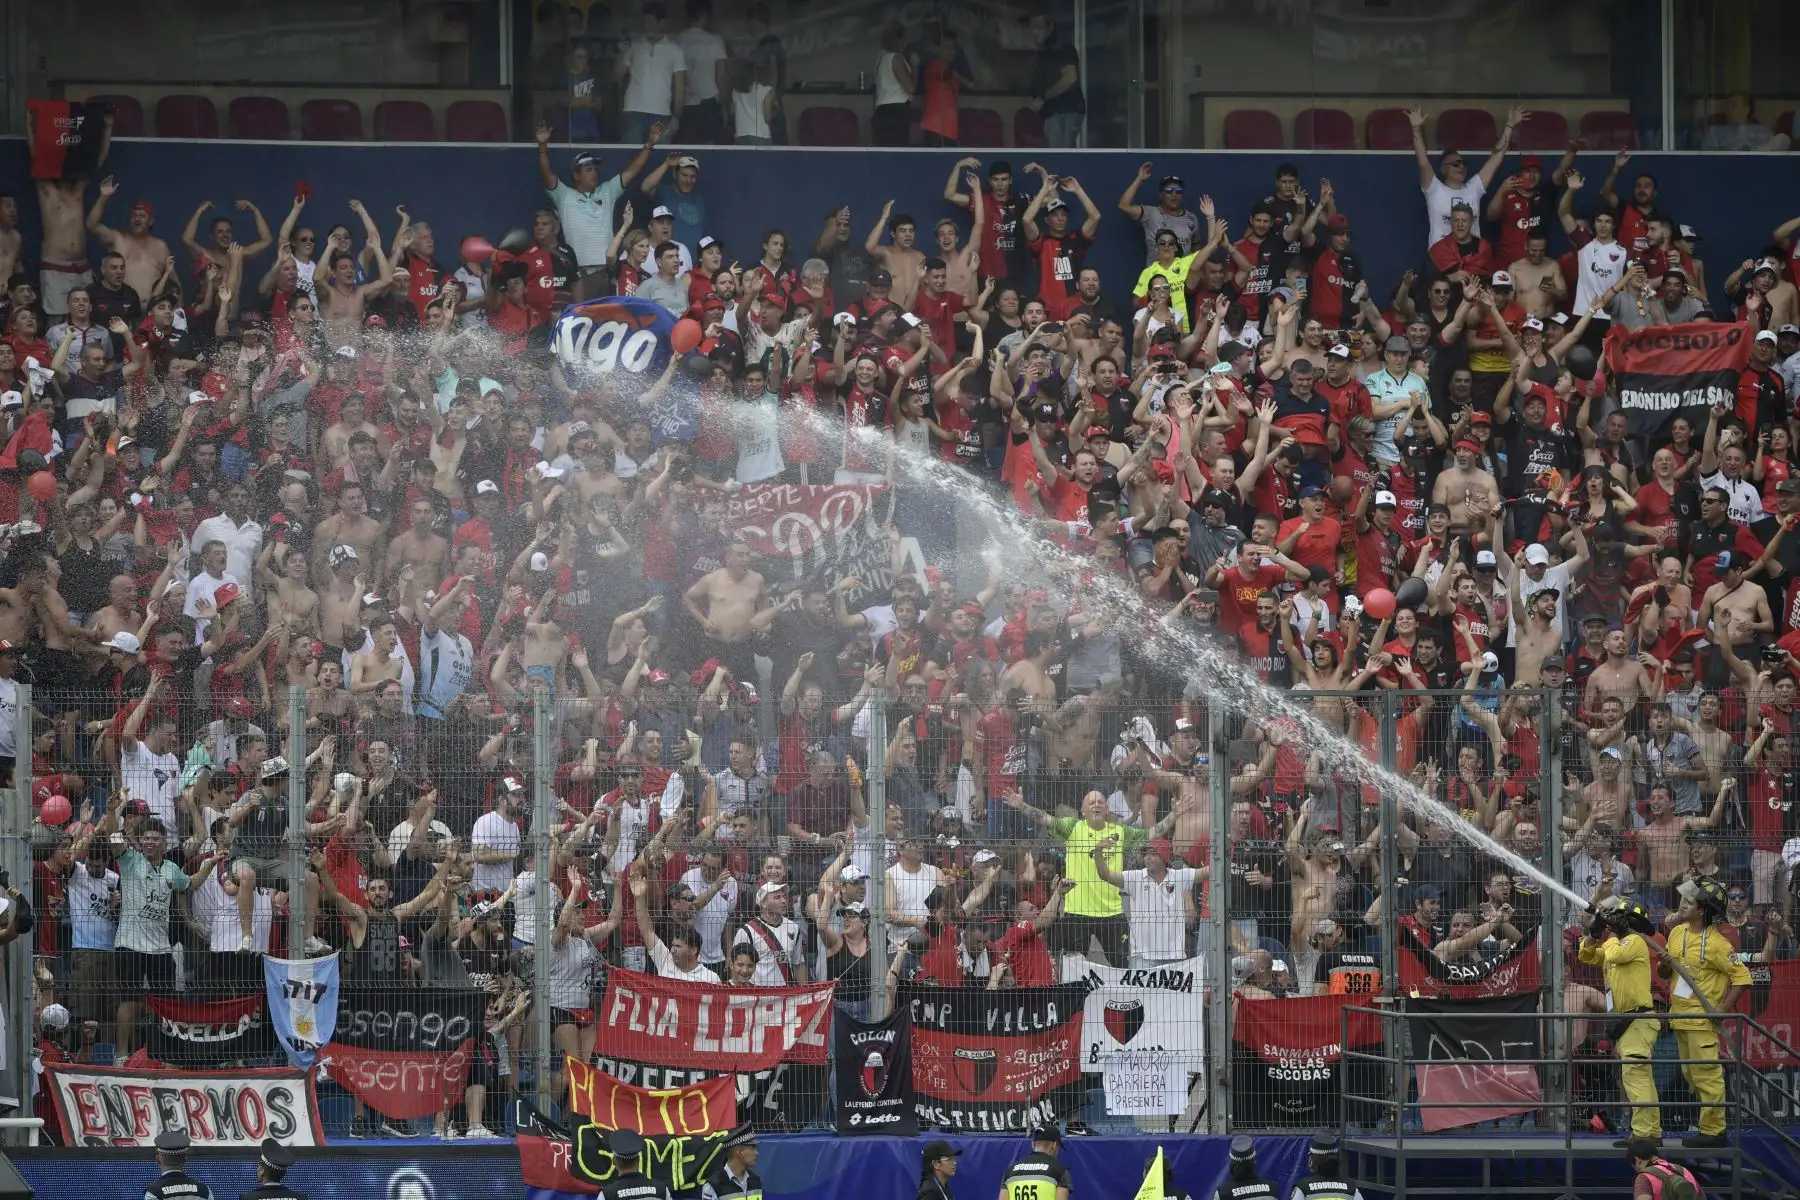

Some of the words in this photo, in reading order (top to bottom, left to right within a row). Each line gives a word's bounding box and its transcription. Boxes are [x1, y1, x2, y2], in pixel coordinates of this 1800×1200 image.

[1681, 388, 1705, 407] DEL
[1341, 954, 1375, 964] CONTROL
[1119, 969, 1194, 994] ARANDA
[693, 986, 835, 1054] LOPEZ
[849, 1029, 896, 1046] COLON
[971, 1050, 994, 1060] COLON
[1267, 1067, 1332, 1081] ESCOBAS
[876, 1098, 904, 1107] CONTINUA
[1114, 1094, 1165, 1108] PRESENTE
[68, 1082, 297, 1140] ENFERMOS
[865, 1113, 901, 1124] lotto
[577, 1123, 729, 1191] GMEZ
[1012, 1162, 1050, 1172] SEGURIDAD
[161, 1183, 198, 1195] SEGURIDAD
[617, 1186, 657, 1198] SEGURIDAD
[1231, 1184, 1271, 1198] SEGURIDAD
[1308, 1180, 1349, 1192] SEGURIDAD
